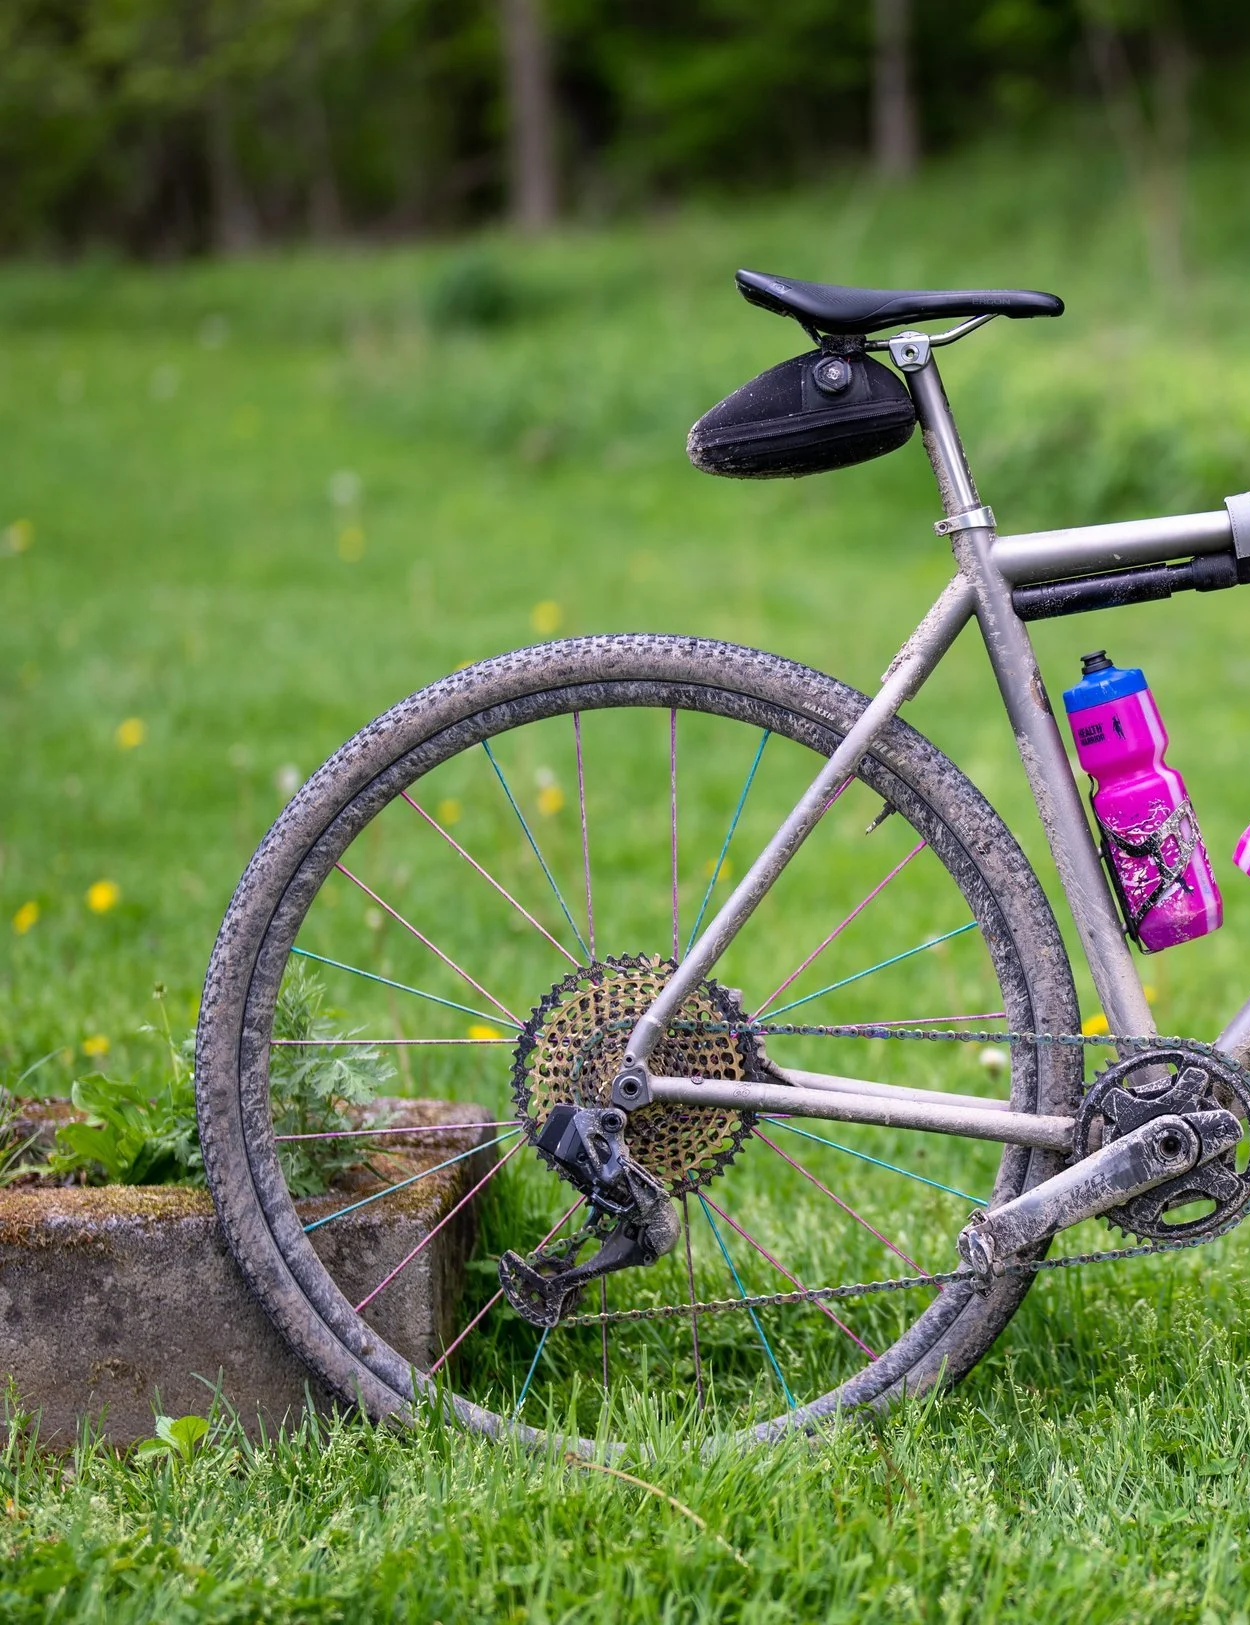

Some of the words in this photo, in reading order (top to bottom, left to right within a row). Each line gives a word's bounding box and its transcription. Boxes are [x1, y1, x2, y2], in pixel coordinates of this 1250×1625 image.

[972, 296, 1011, 305] ERGON
[801, 701, 836, 721] MAXXIS
[840, 720, 907, 768] RBLER
[1078, 723, 1103, 738] HEALTH
[559, 973, 578, 992] EAGLE
